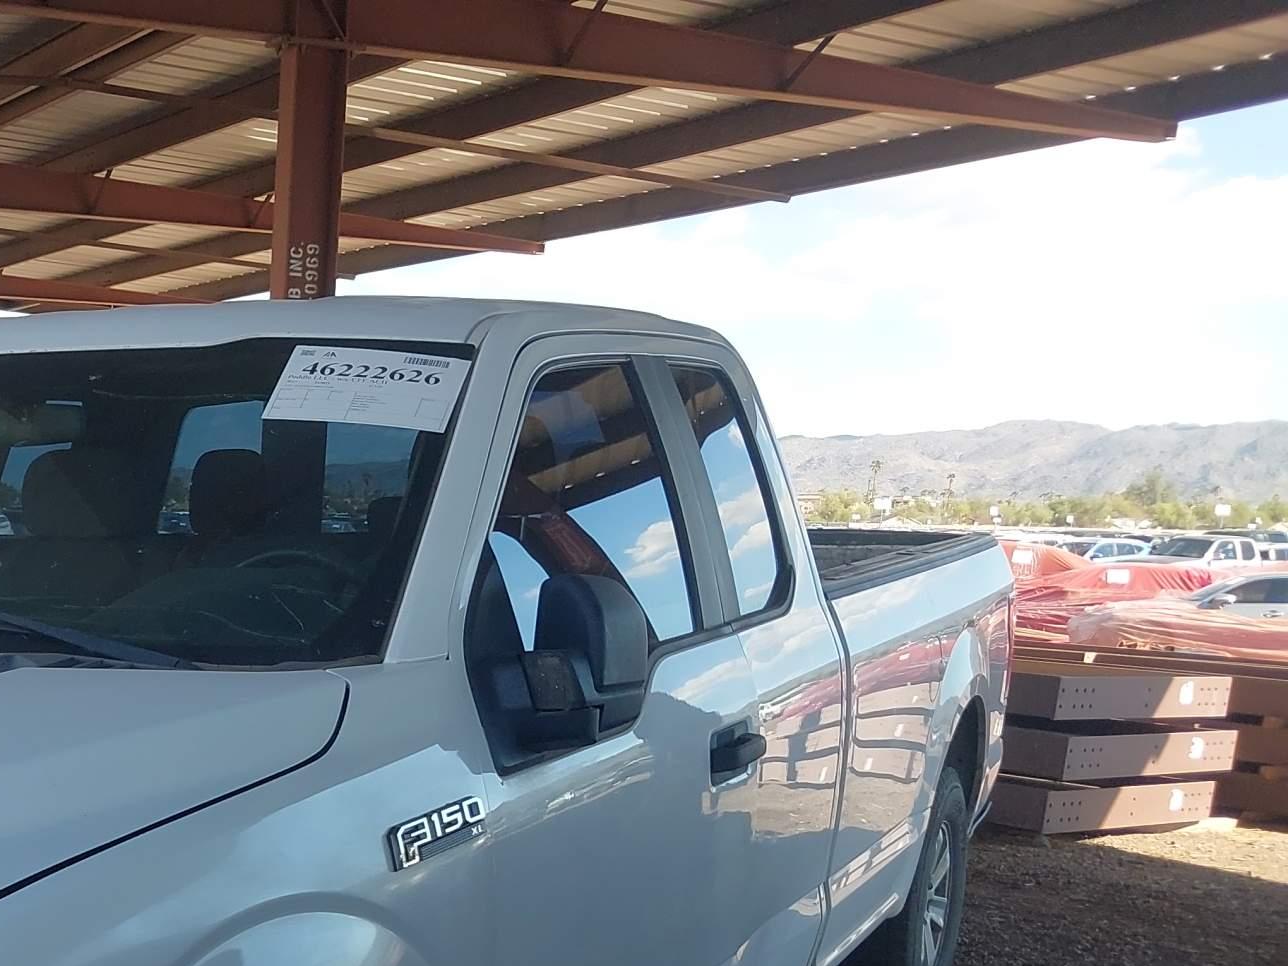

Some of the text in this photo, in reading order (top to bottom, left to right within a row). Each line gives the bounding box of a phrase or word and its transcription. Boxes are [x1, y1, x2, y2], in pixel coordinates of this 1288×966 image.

[289, 242, 304, 277] INC.
[302, 361, 444, 386] 46222626
[472, 824, 483, 836] XL
